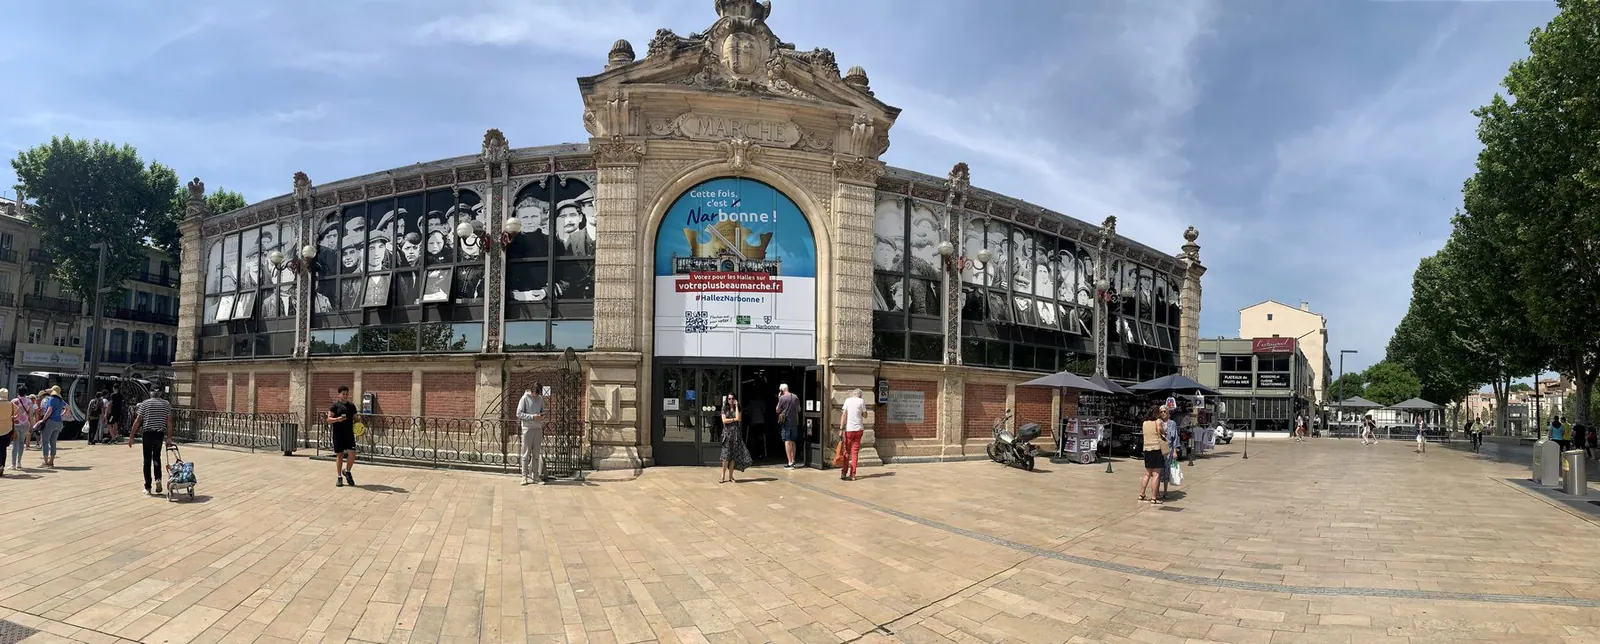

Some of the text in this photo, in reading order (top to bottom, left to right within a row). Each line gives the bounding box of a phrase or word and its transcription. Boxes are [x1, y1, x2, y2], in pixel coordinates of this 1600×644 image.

[690, 189, 738, 199] Cette fois,
[706, 199, 728, 207] c'est
[686, 206, 777, 225] Narbonne !
[678, 282, 780, 290] votreplusbeaumarche.fr
[696, 294, 760, 303] #HallezNarbonne
